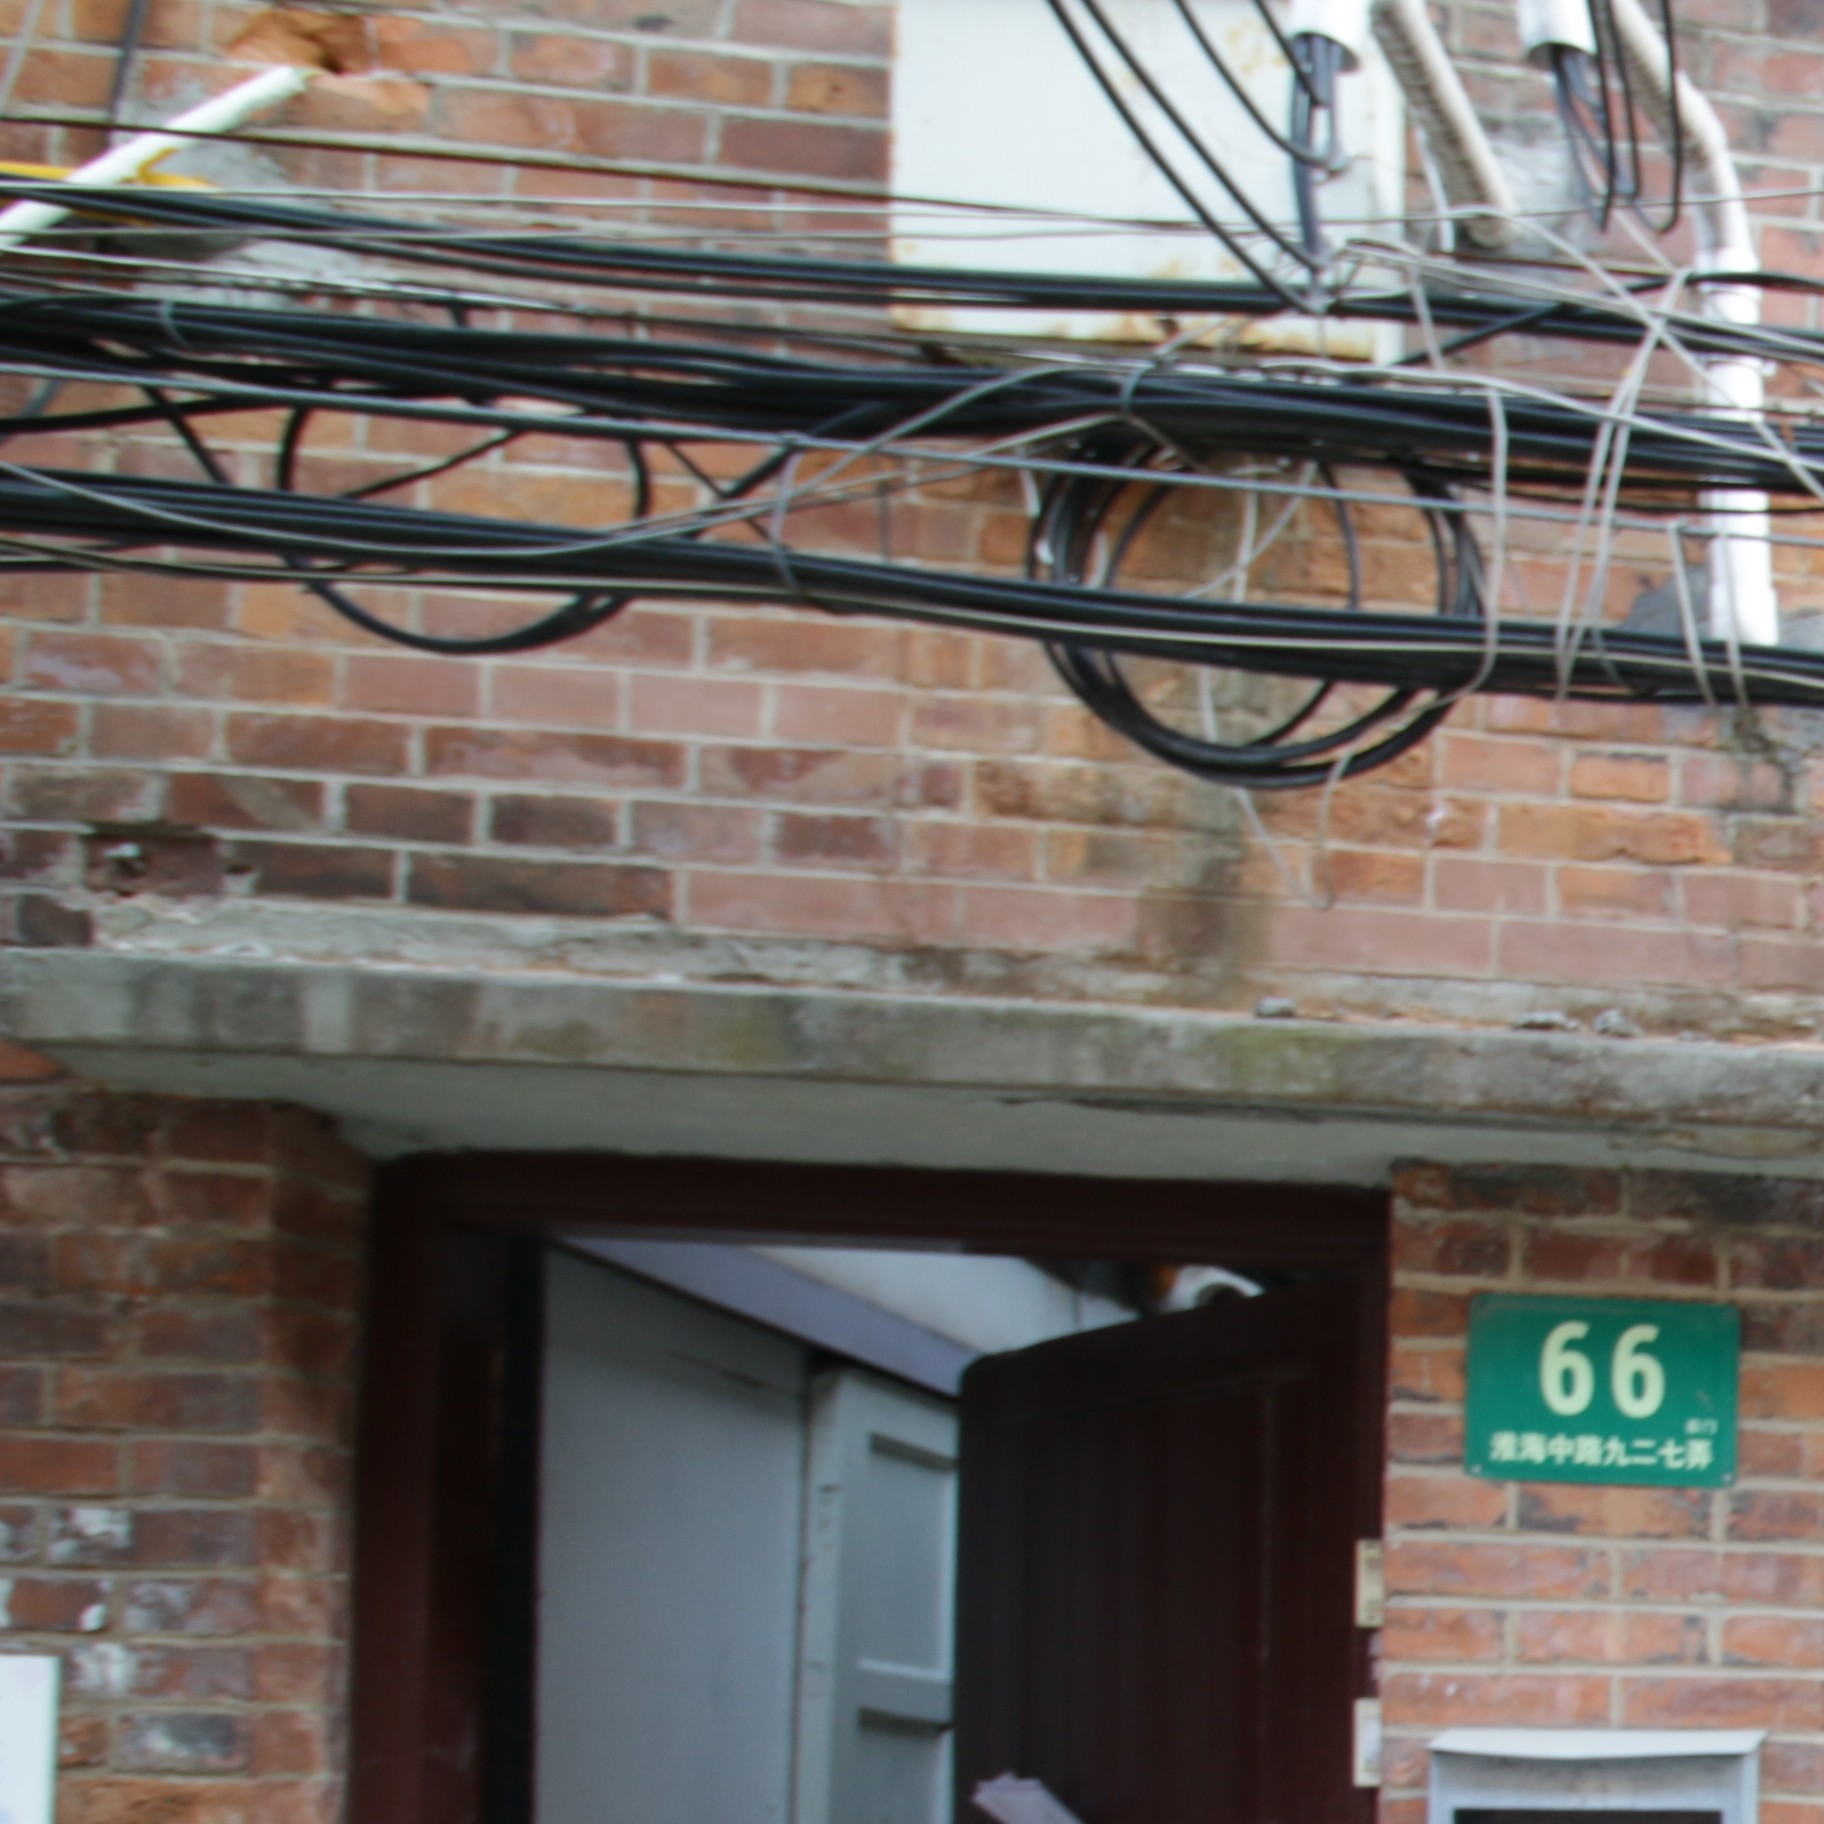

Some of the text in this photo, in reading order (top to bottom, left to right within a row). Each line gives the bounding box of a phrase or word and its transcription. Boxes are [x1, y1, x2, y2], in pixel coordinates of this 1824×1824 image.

[1539, 1319, 1667, 1420] 66
[1490, 1431, 1713, 1470] 淮海中路九二七弄
